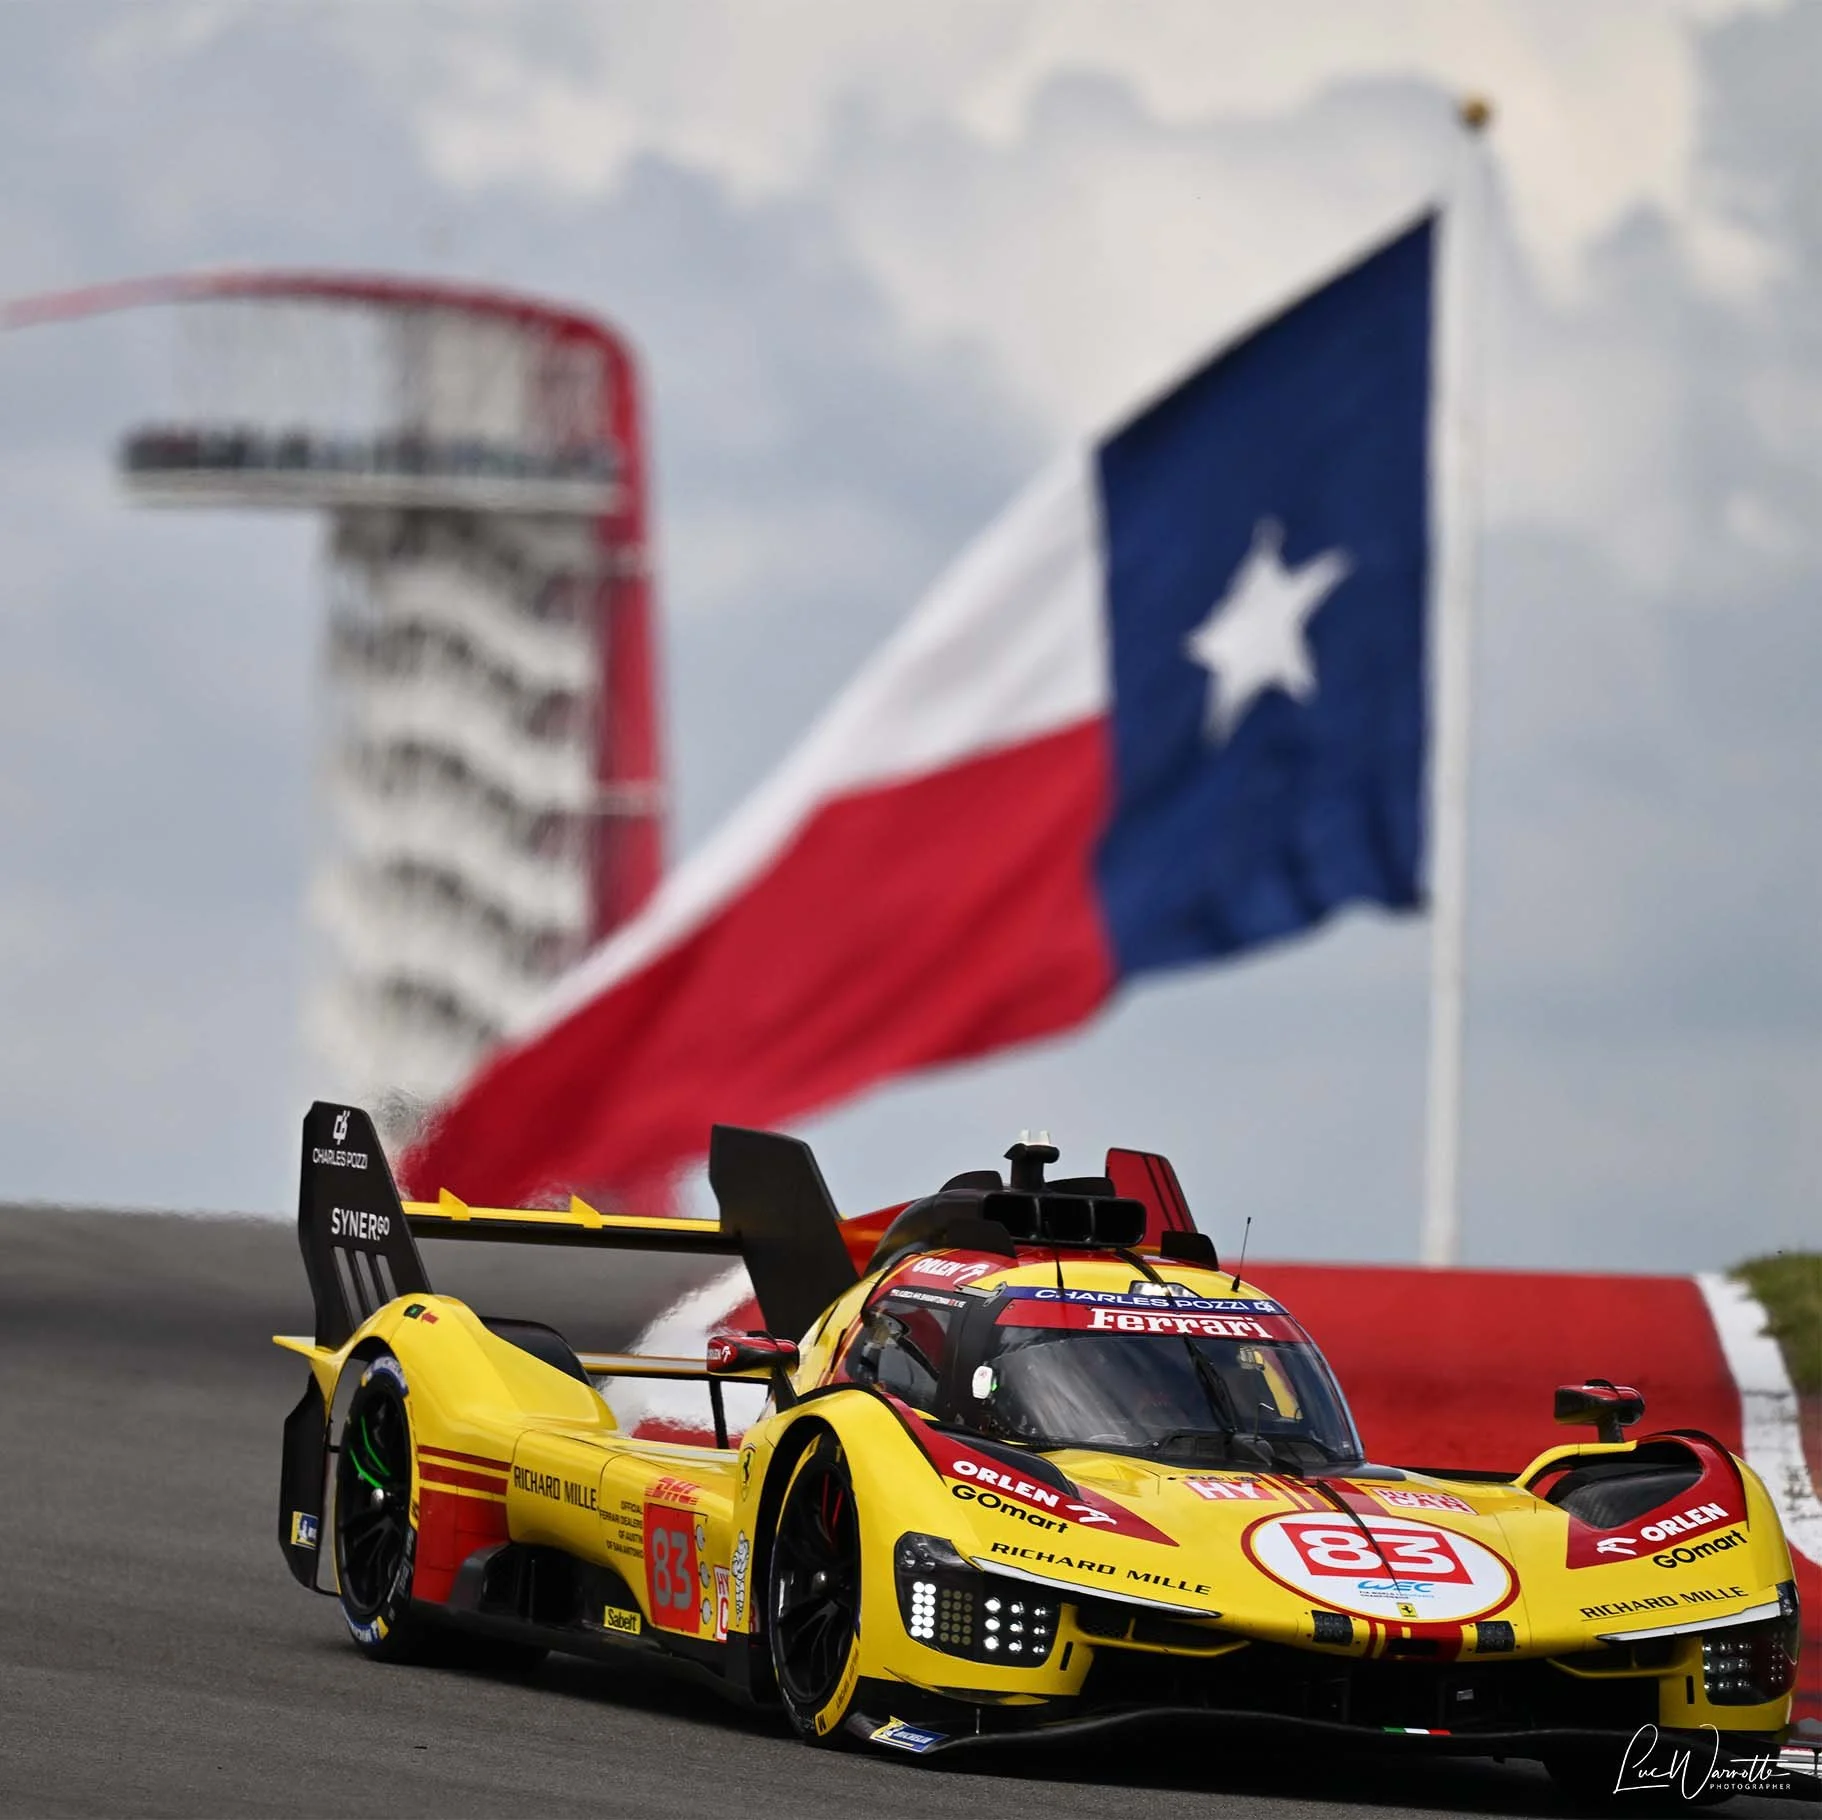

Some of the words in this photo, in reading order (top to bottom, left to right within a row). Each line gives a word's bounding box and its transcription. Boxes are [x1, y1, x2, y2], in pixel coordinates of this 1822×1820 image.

[312, 1148, 346, 1167] CHARLES
[346, 1153, 368, 1170] POZZI
[912, 1257, 966, 1277] ORLEN
[1035, 1289, 1169, 1308] CHARLES
[1176, 1300, 1248, 1310] POZZI
[1087, 1308, 1273, 1338] Ferrari
[514, 1468, 561, 1500] RICHARD
[952, 1460, 1059, 1507] ORLEN
[1186, 1482, 1262, 1498] HY
[951, 1484, 1068, 1534] GOmart
[1641, 1502, 1729, 1542] ORLEN
[1299, 1529, 1456, 1574] 83
[1652, 1530, 1748, 1569] GOmart
[651, 1527, 692, 1610] 83
[991, 1542, 1116, 1575] RICHARD
[1127, 1570, 1212, 1595] MILLE
[1357, 1581, 1435, 1593] WEC
[1580, 1596, 1679, 1619] RICHARD
[1680, 1587, 1749, 1605] MILLE
[608, 1608, 636, 1631] Sabelt
